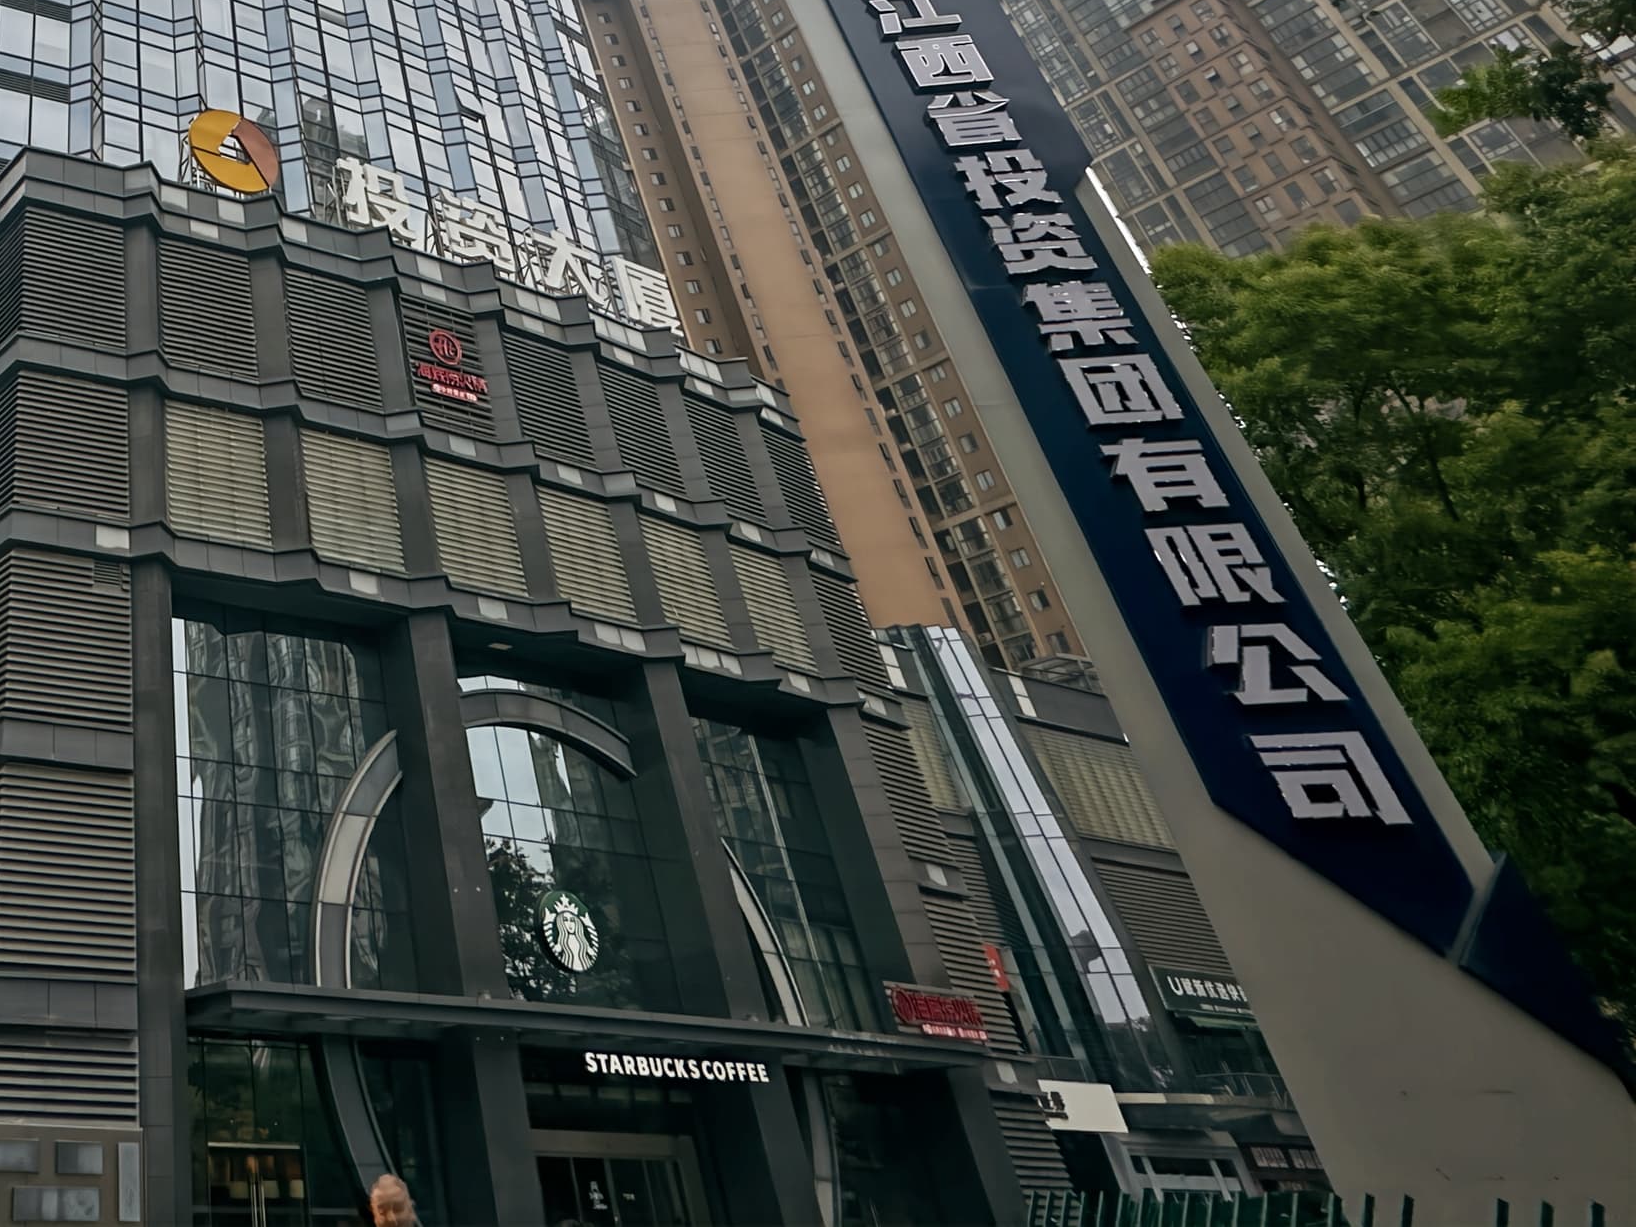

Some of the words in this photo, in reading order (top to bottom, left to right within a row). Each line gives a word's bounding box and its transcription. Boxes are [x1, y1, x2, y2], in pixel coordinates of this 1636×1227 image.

[336, 156, 681, 339] 投资大厦
[584, 1051, 701, 1080] STARBUCKS
[701, 1059, 770, 1084] COFFEE
